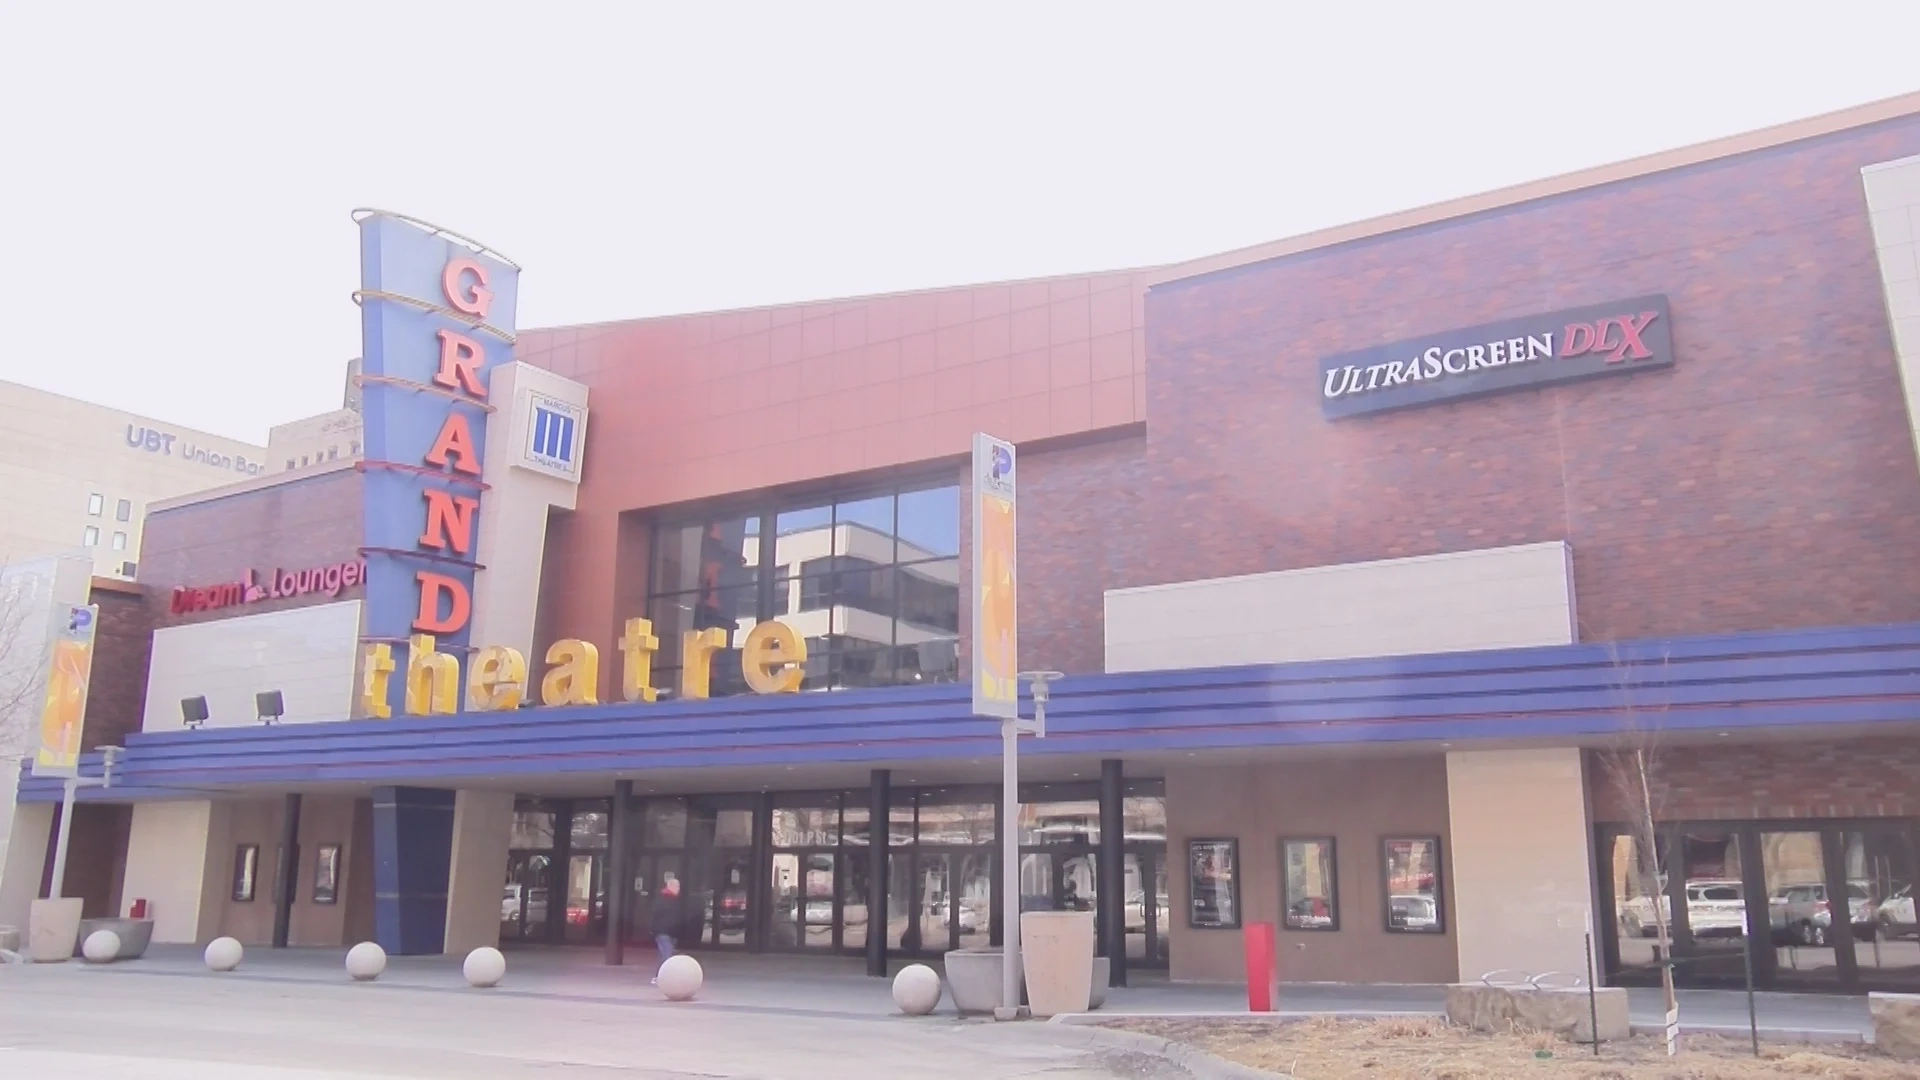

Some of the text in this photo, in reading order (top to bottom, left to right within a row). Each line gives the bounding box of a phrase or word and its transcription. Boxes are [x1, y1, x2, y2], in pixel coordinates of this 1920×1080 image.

[1559, 310, 1658, 364] DLX
[126, 423, 177, 455] UBT
[183, 443, 231, 469] Union
[412, 258, 492, 634] GRAND
[171, 584, 242, 614] Dream
[363, 618, 808, 719] theatre
